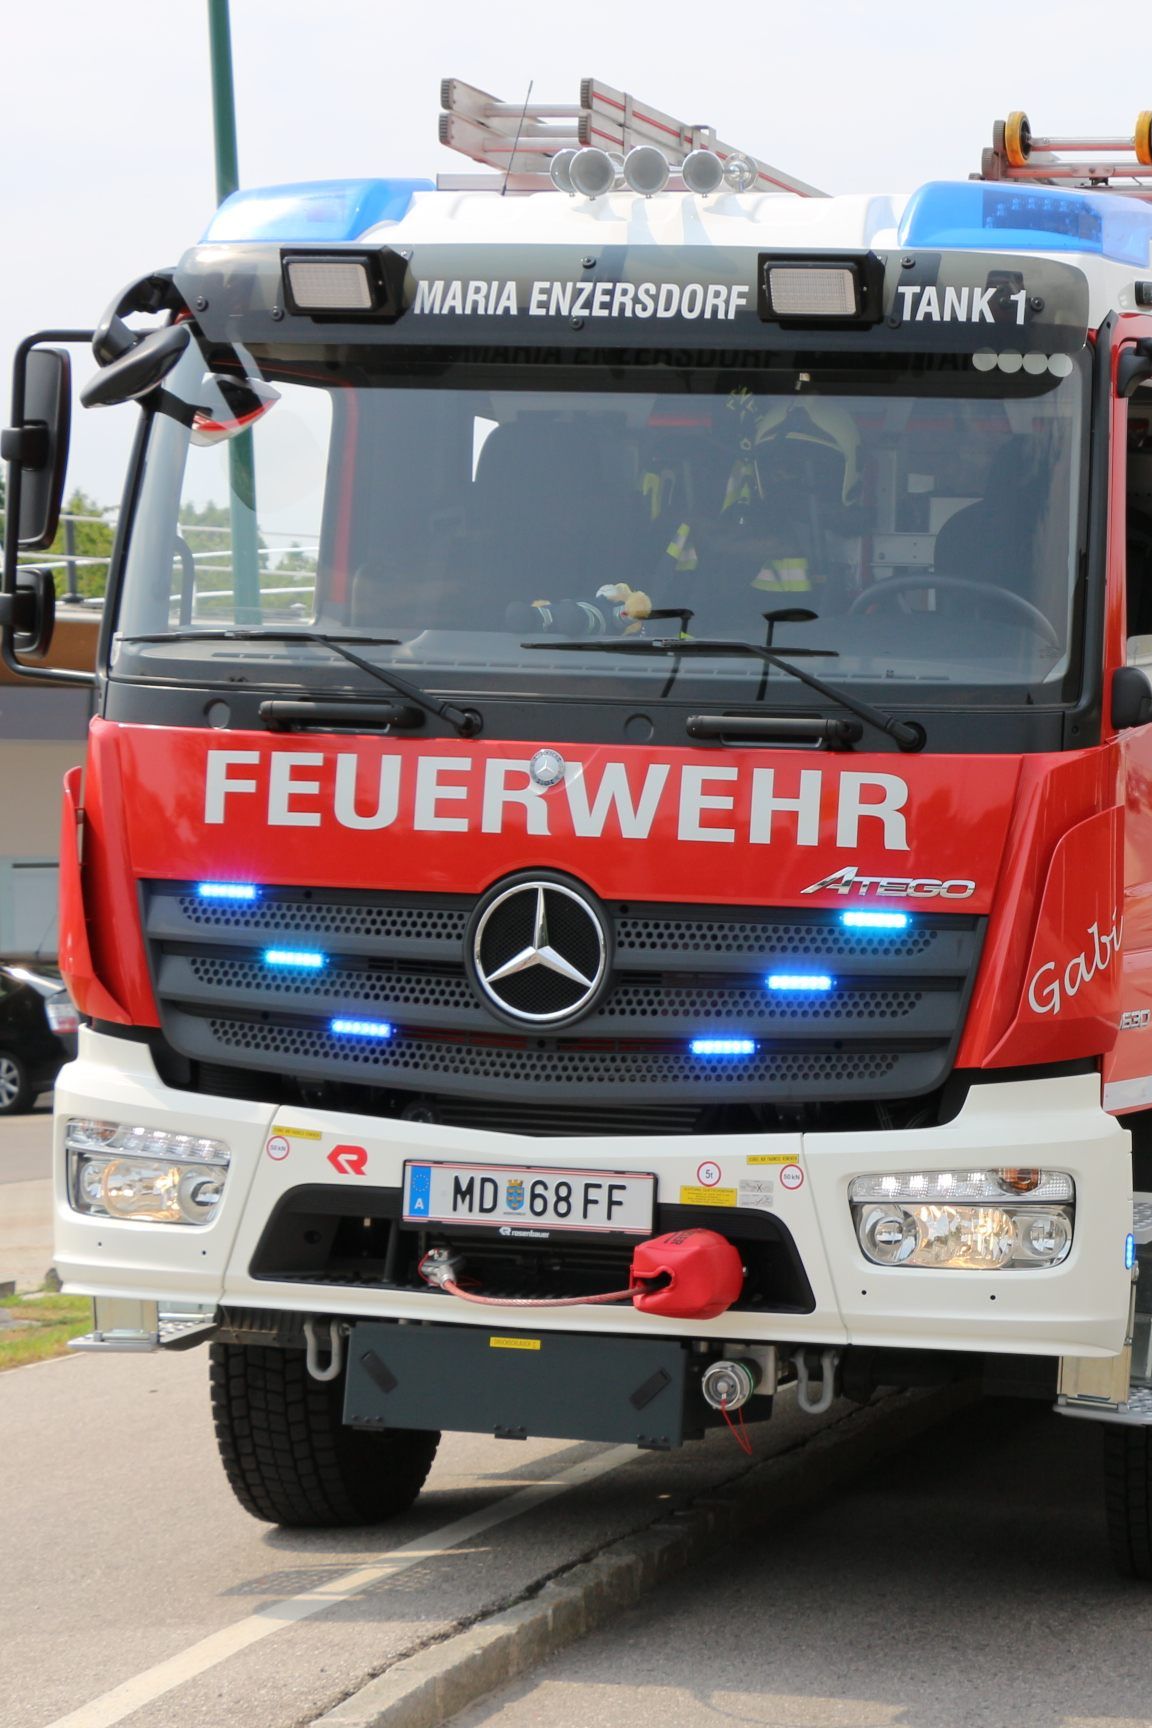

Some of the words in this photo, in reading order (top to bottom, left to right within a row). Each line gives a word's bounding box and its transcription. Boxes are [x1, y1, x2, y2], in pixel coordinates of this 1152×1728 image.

[413, 280, 519, 316] MARIA
[528, 281, 749, 321] ENZERSDORF
[897, 285, 998, 324] TANK
[1010, 289, 1027, 326] 1
[203, 749, 911, 853] FEUERWEHR
[800, 866, 976, 899] ATEGO
[1028, 905, 1124, 1016] Gabi
[414, 1198, 424, 1210] A
[452, 1175, 499, 1214] MD
[511, 1228, 550, 1239] rosenbauer
